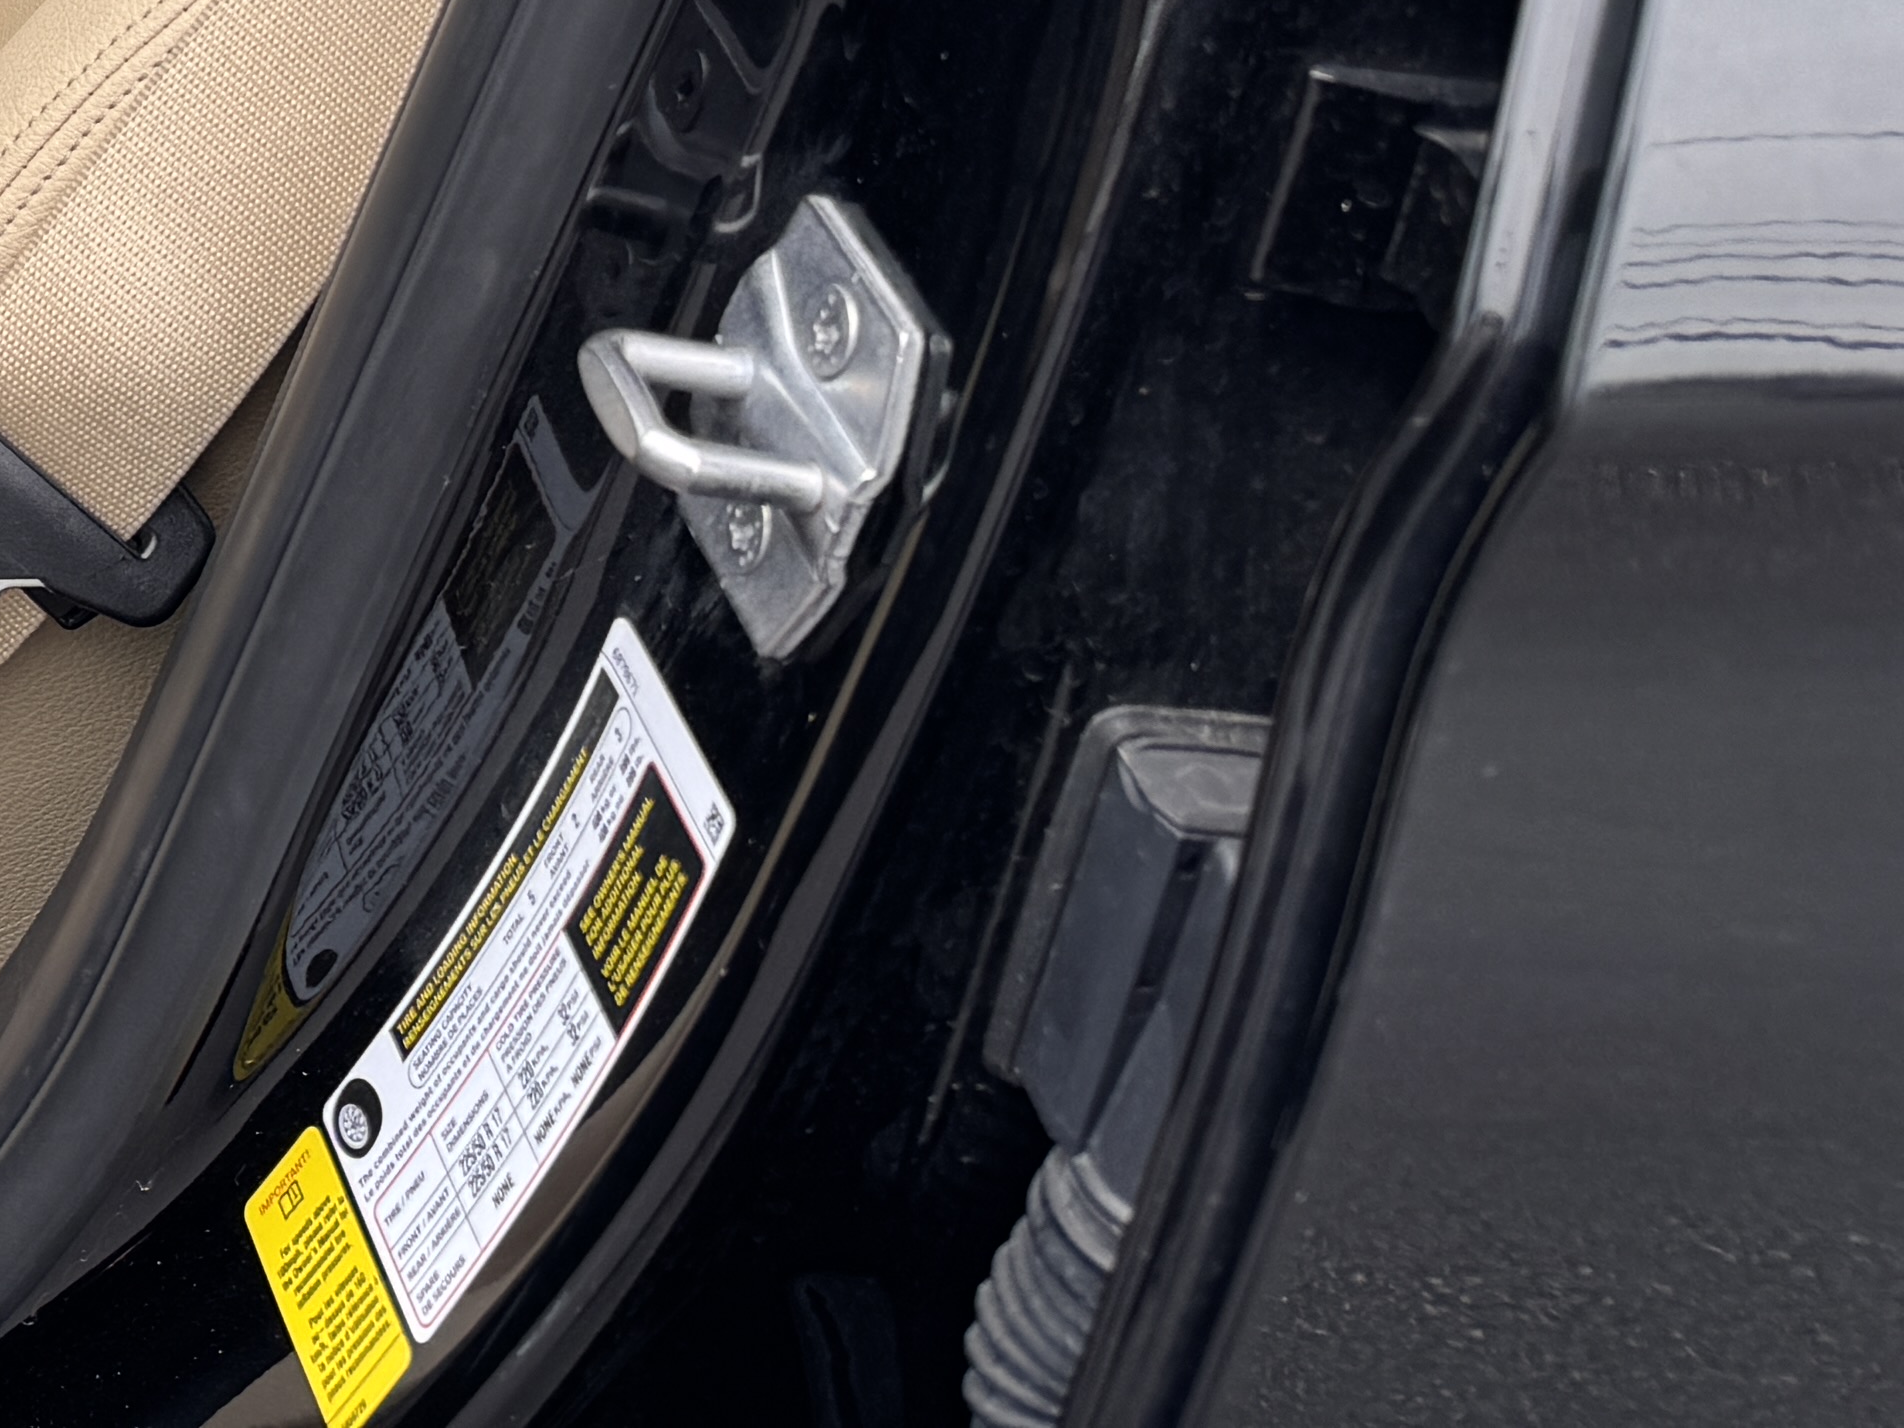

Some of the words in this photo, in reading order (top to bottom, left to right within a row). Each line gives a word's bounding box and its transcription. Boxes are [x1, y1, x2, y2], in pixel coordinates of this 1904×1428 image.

[613, 725, 623, 744] 3
[543, 831, 564, 869] FRONT
[570, 810, 580, 829] 2
[548, 841, 569, 880] AVANT
[578, 903, 596, 935] SEE
[592, 845, 626, 911] OWNER'S
[622, 791, 653, 856] MANUAL
[585, 914, 603, 948] FOR
[599, 839, 643, 924] ADDITIONAL
[639, 889, 662, 935] POUR
[658, 854, 681, 899] PLUS
[402, 945, 472, 1051] RENSEIGNEMENTS
[469, 921, 488, 952] SUR
[485, 898, 502, 928] LES
[499, 859, 525, 906] PNEUS
[522, 843, 535, 866] ET
[531, 826, 544, 850] LE
[541, 744, 587, 834] CHARGEMENT
[502, 910, 524, 946] TOTAL
[526, 887, 537, 907] 5
[600, 942, 621, 981] VOIR
[617, 925, 630, 951] LE
[626, 871, 658, 934] MANUEL
[654, 852, 668, 880] DE
[396, 1005, 417, 1038] TIRE
[415, 980, 435, 1012] AND
[431, 930, 468, 987] LOADING
[465, 848, 518, 937] INFORMATION
[412, 1026, 442, 1071] SEATING
[440, 980, 473, 1031] CAPACITY
[495, 1021, 514, 1053] COLD
[513, 997, 529, 1024] TIRE
[527, 945, 560, 1002] PRESSURE
[500, 1011, 533, 1064] PRESSION
[531, 990, 546, 1015] DES
[613, 980, 628, 1009] DE
[417, 1036, 448, 1082] NOMBRE
[446, 1021, 458, 1040] DE
[456, 984, 483, 1026] PLACES
[511, 1030, 532, 1065] FROID
[357, 1165, 373, 1189] The
[372, 1118, 409, 1171] combined
[407, 1084, 434, 1125] weight
[440, 1022, 478, 1079] occupants
[476, 1002, 490, 1026] and
[373, 1158, 396, 1192] poids
[394, 1134, 413, 1162] total
[411, 1115, 427, 1139] des
[425, 1065, 463, 1121] occupants
[479, 978, 520, 1043] chargement
[516, 1057, 535, 1091] 220
[525, 1077, 545, 1112] 220
[532, 1107, 556, 1148] NONE
[569, 1049, 593, 1090] NONE
[440, 1115, 457, 1142] SIZE
[446, 1088, 489, 1154] DIMENSIONS
[457, 1129, 487, 1178] 225/50
[490, 1104, 504, 1130] 17
[257, 1148, 312, 1216] IMPORTANT!
[466, 1150, 496, 1199] 225/50
[499, 1125, 513, 1151] 17
[490, 1170, 515, 1211] NONE
[383, 1201, 401, 1228] TIRE
[404, 1168, 426, 1201] PNEU
[397, 1223, 422, 1260] FRONT
[425, 1185, 450, 1223] AVANT
[406, 1251, 427, 1282] REAR
[415, 1269, 439, 1304] SPARE
[431, 1253, 466, 1303] SECOURS
